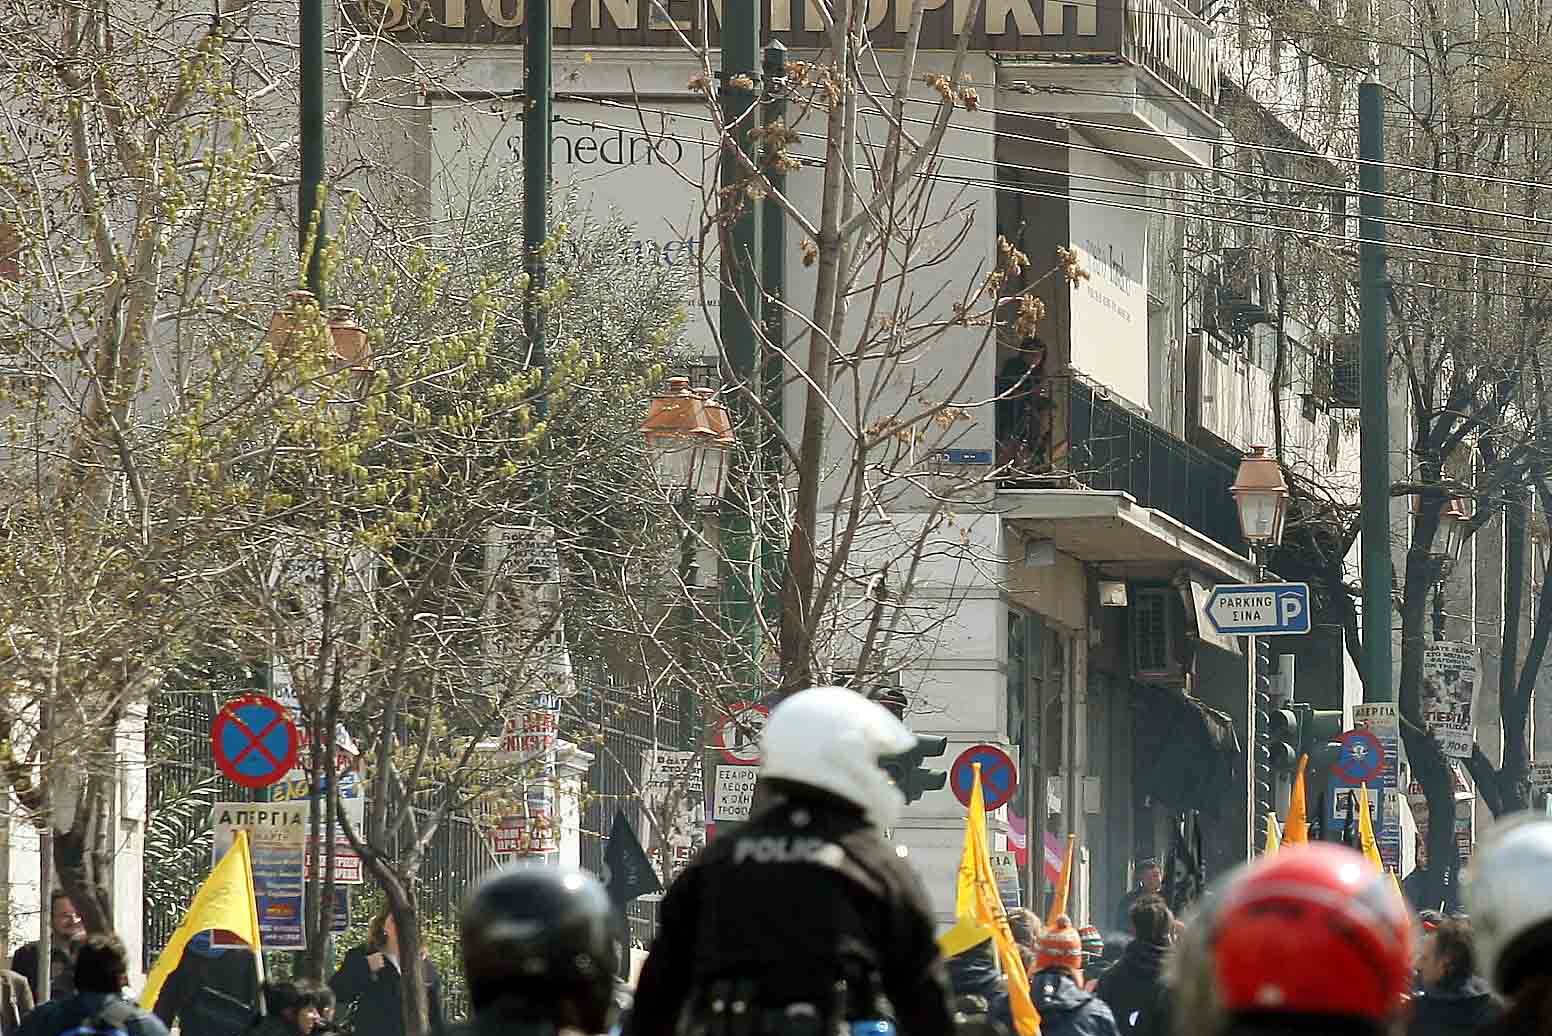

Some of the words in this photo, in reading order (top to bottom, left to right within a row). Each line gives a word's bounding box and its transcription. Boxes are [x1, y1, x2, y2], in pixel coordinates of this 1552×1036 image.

[1220, 596, 1272, 608] PARKING
[1233, 610, 1261, 622] ΣΙΝΑ
[219, 810, 302, 826] ΑΠΕΡΓΙΑ
[733, 835, 824, 864] POLIC
